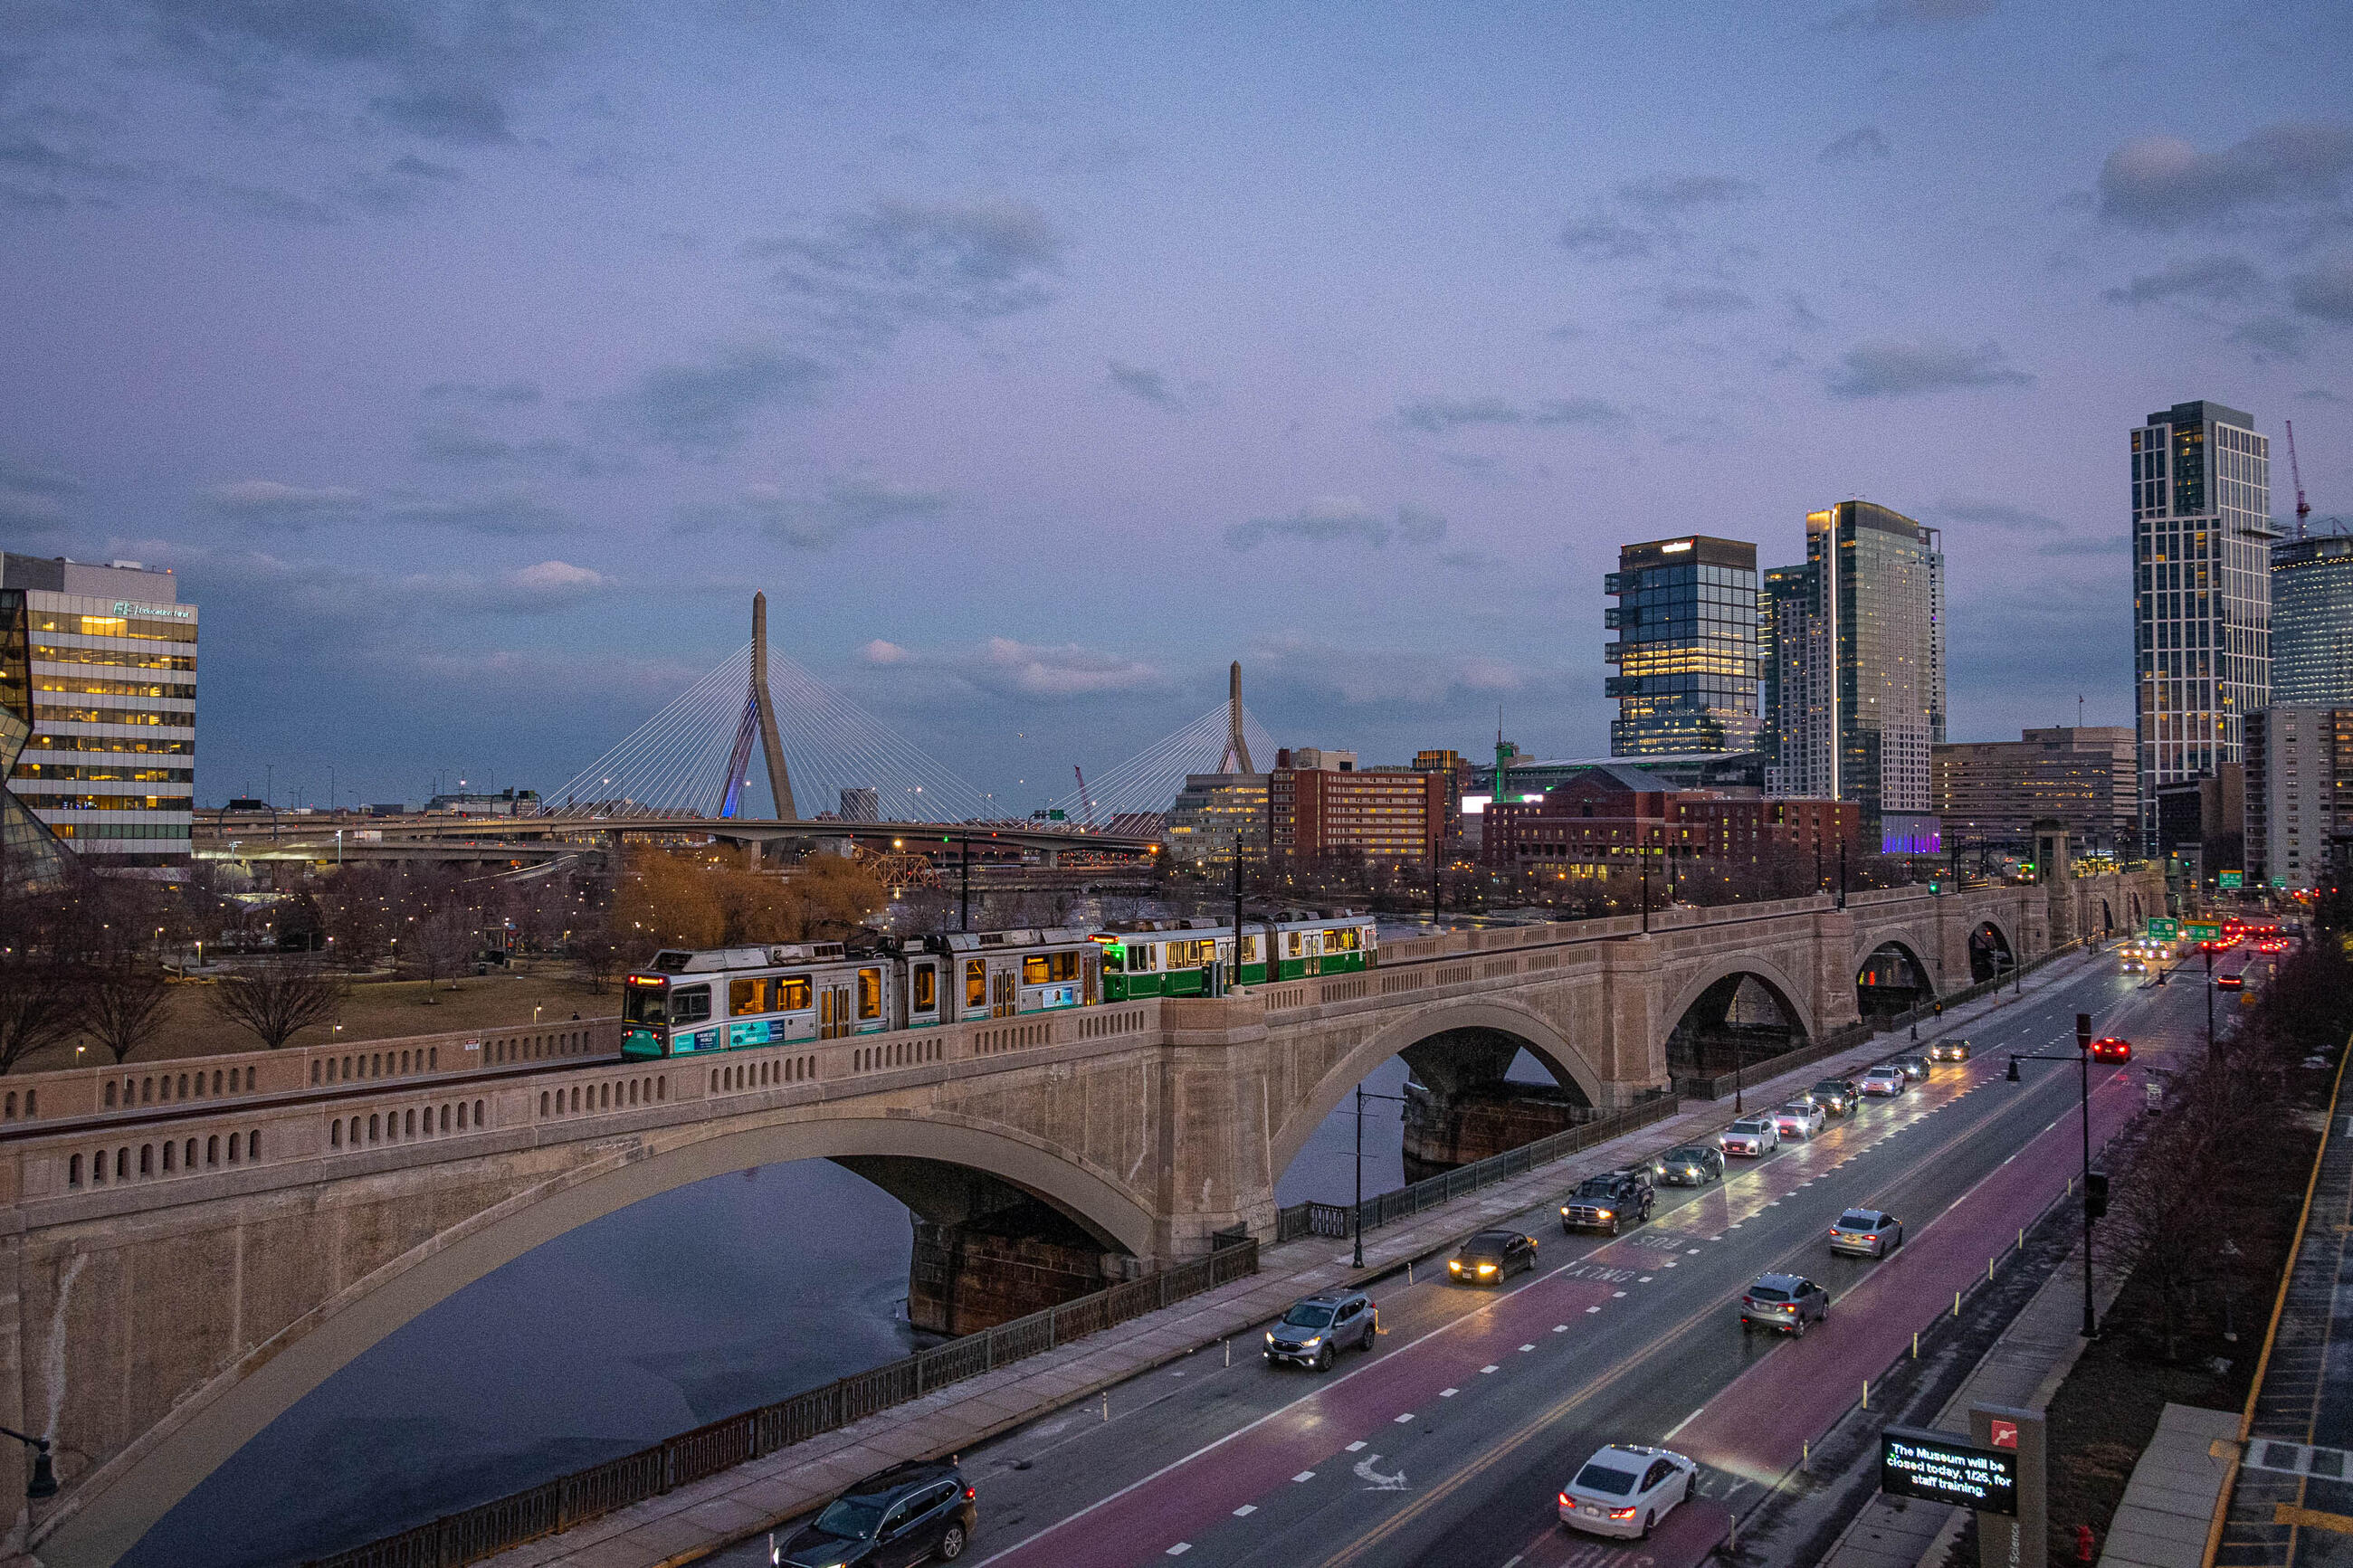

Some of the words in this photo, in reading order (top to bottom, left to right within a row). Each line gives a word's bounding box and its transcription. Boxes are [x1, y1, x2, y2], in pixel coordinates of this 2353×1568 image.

[1567, 1265, 1635, 1283] ONLY
[1887, 1456, 1925, 1472] closed
[1926, 1463, 1964, 1480] today,
[1994, 1474, 2013, 1487] for
[1891, 1443, 1914, 1457] The
[1916, 1448, 1966, 1466] Museum
[1967, 1458, 1987, 1469] will
[1990, 1459, 2005, 1472] be
[1911, 1474, 1938, 1487] staff
[1939, 1479, 1986, 1497] training.
[2008, 1522, 2020, 1563] Science
